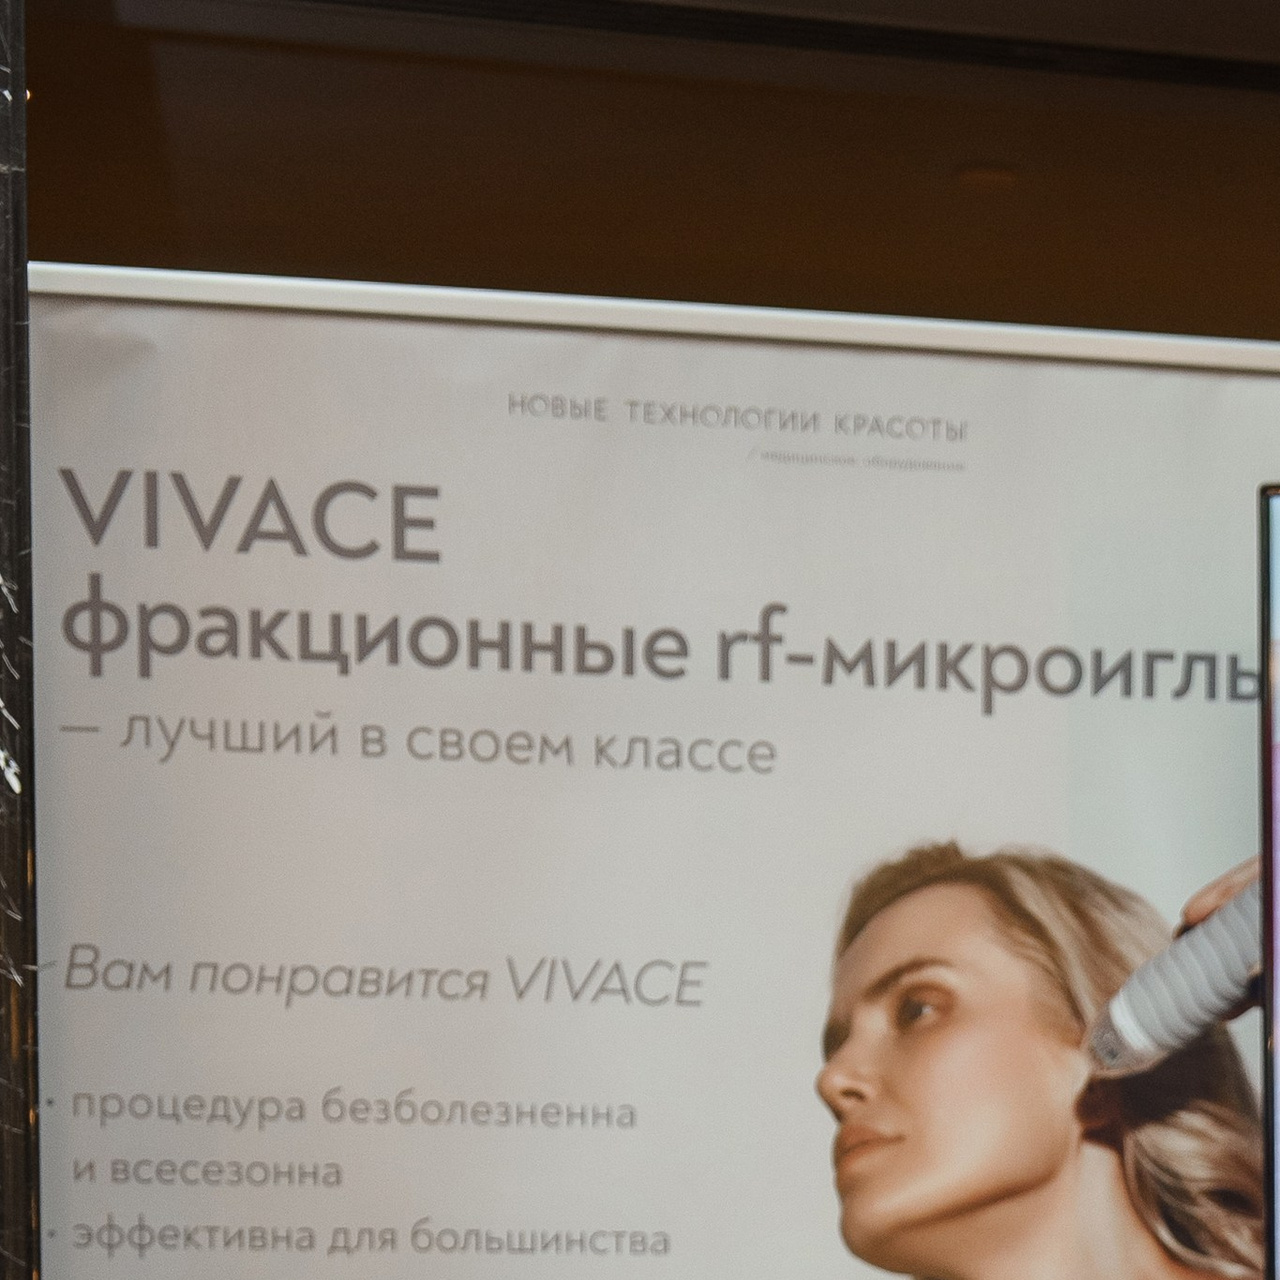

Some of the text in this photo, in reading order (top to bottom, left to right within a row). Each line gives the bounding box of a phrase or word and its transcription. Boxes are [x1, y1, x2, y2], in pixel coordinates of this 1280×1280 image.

[508, 393, 968, 442] НОВЫЕ ТЕХНОЛОГИИ КРАСОТЫ
[57, 467, 442, 564] VIVACE
[61, 572, 690, 679] фракционные
[120, 711, 339, 763] лучший
[361, 724, 387, 757] в
[406, 725, 574, 766] своем
[594, 733, 778, 775] классе
[65, 944, 709, 1009] Вам понравится VIVACE
[72, 1087, 638, 1131] процедура безболезненна
[73, 1156, 344, 1188] и всесезонна
[72, 1212, 672, 1260] эффективна для большинства
